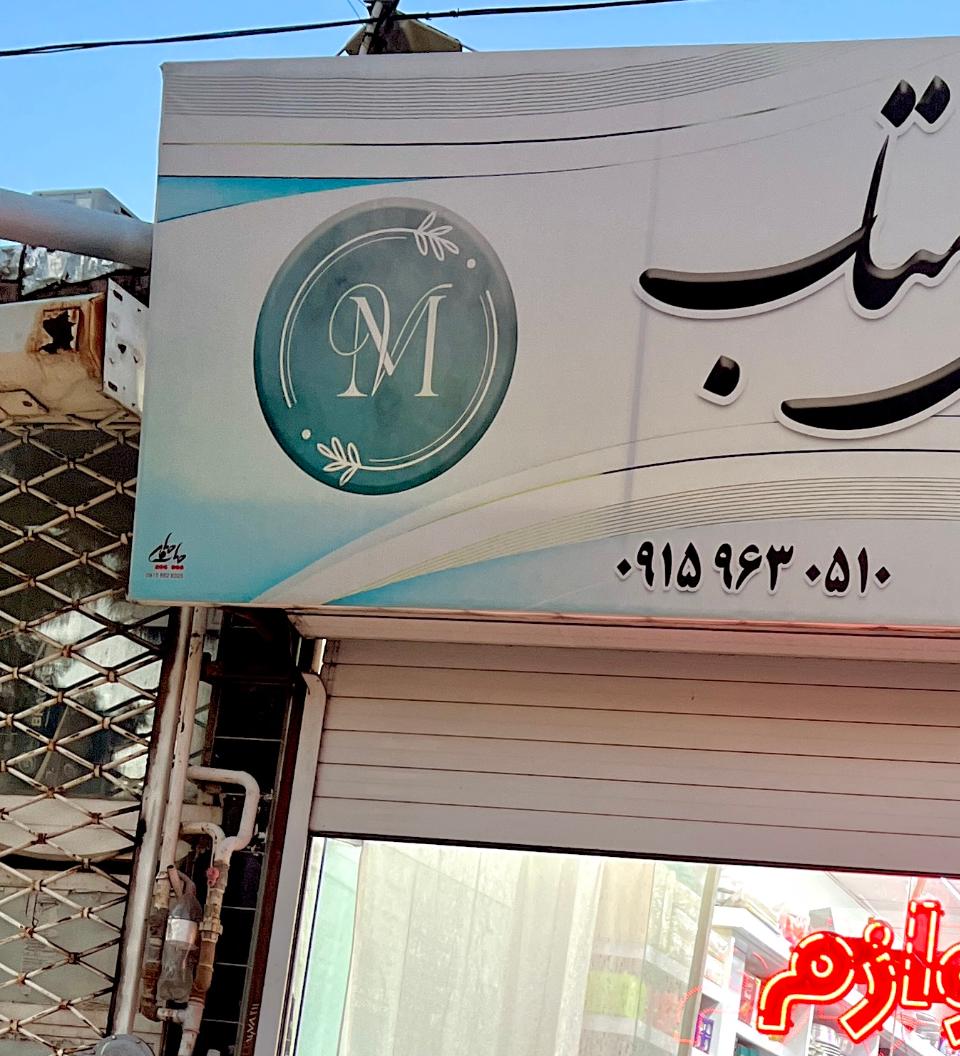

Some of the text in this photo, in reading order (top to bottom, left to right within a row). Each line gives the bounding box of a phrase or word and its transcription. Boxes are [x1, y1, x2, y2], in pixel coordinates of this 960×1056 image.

[616, 541, 891, 594] ۰۹۱۵ ۹۶۳ ۰۵۱۰
